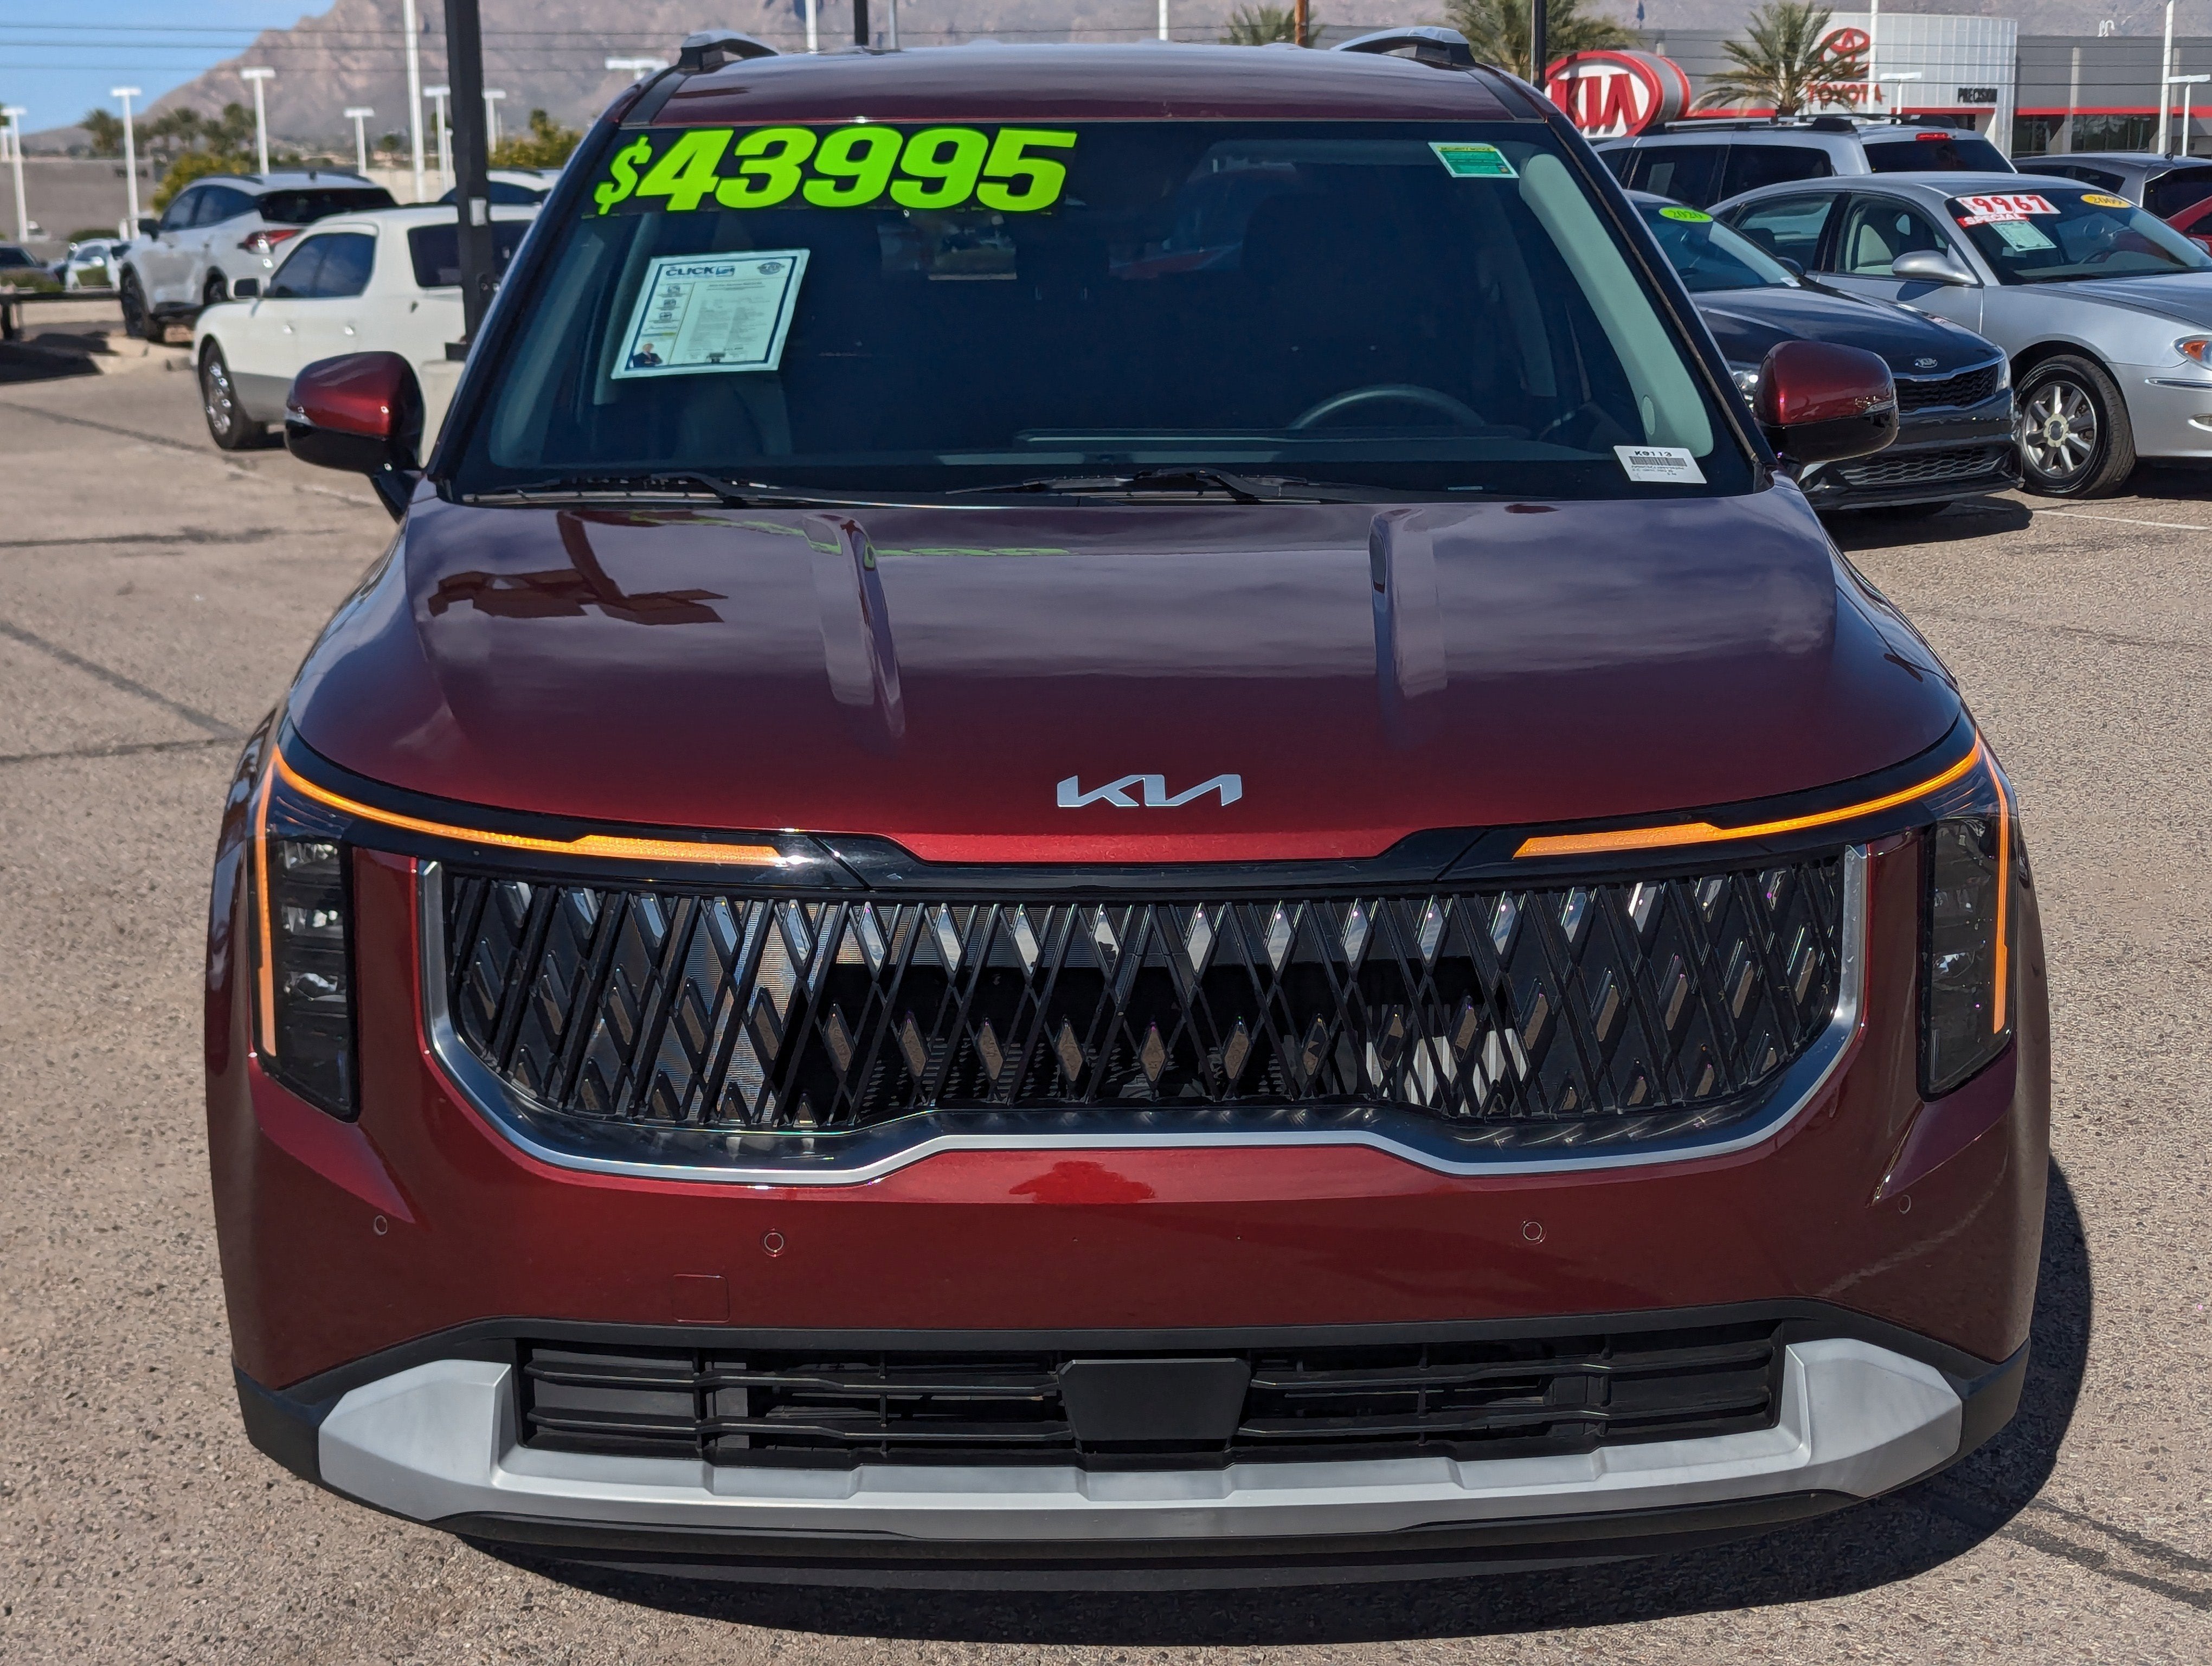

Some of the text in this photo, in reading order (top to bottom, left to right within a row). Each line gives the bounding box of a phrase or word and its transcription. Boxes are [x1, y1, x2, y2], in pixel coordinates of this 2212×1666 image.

[1548, 74, 1639, 128] KIA
[593, 125, 1078, 214] $43995
[1057, 774, 1242, 807] KIA
